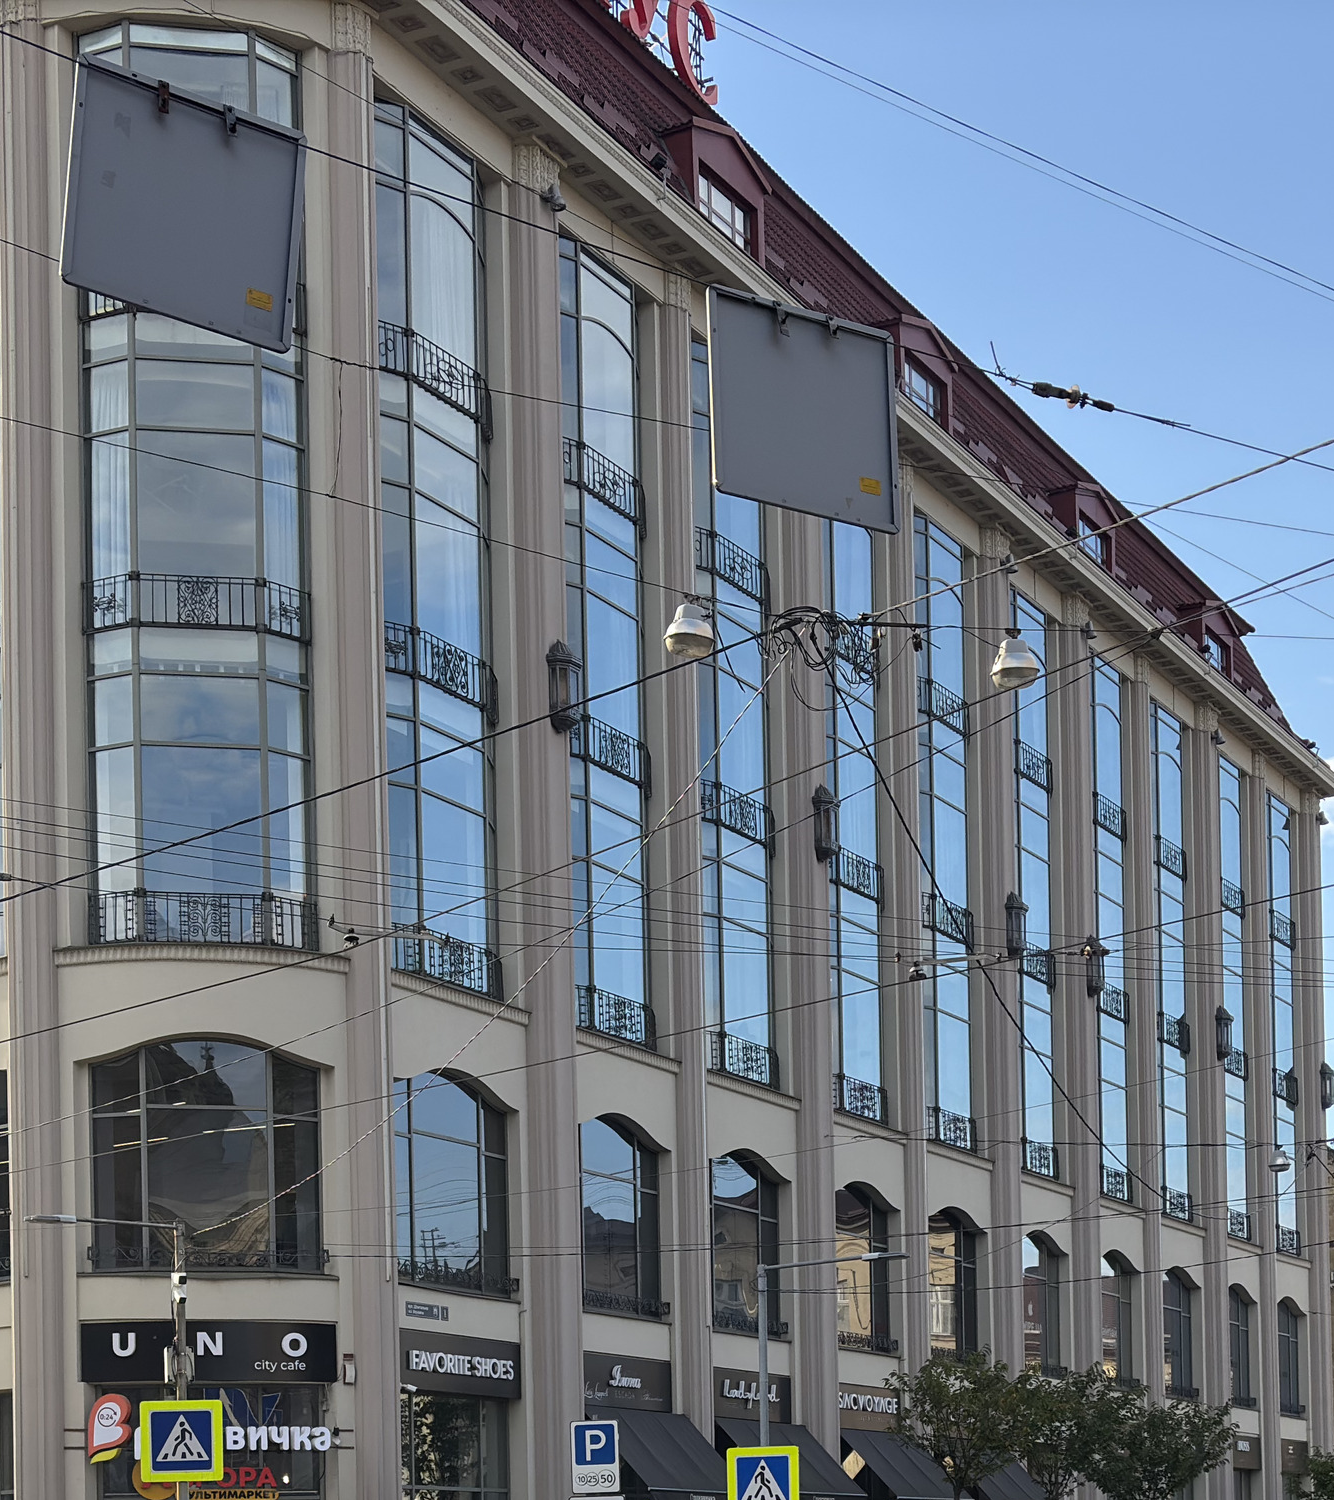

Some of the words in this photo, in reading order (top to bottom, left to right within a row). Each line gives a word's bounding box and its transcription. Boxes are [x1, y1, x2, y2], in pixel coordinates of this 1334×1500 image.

[254, 1359, 278, 1373] city
[280, 1359, 307, 1371] cafe
[410, 1350, 472, 1376] FAVORITE
[474, 1356, 515, 1381] SHOES
[838, 1391, 898, 1415] SACVOYAGE
[587, 1475, 598, 1483] 25
[600, 1474, 613, 1484] 50
[188, 1490, 278, 1500] УЛЬТИМАРКЕТ
